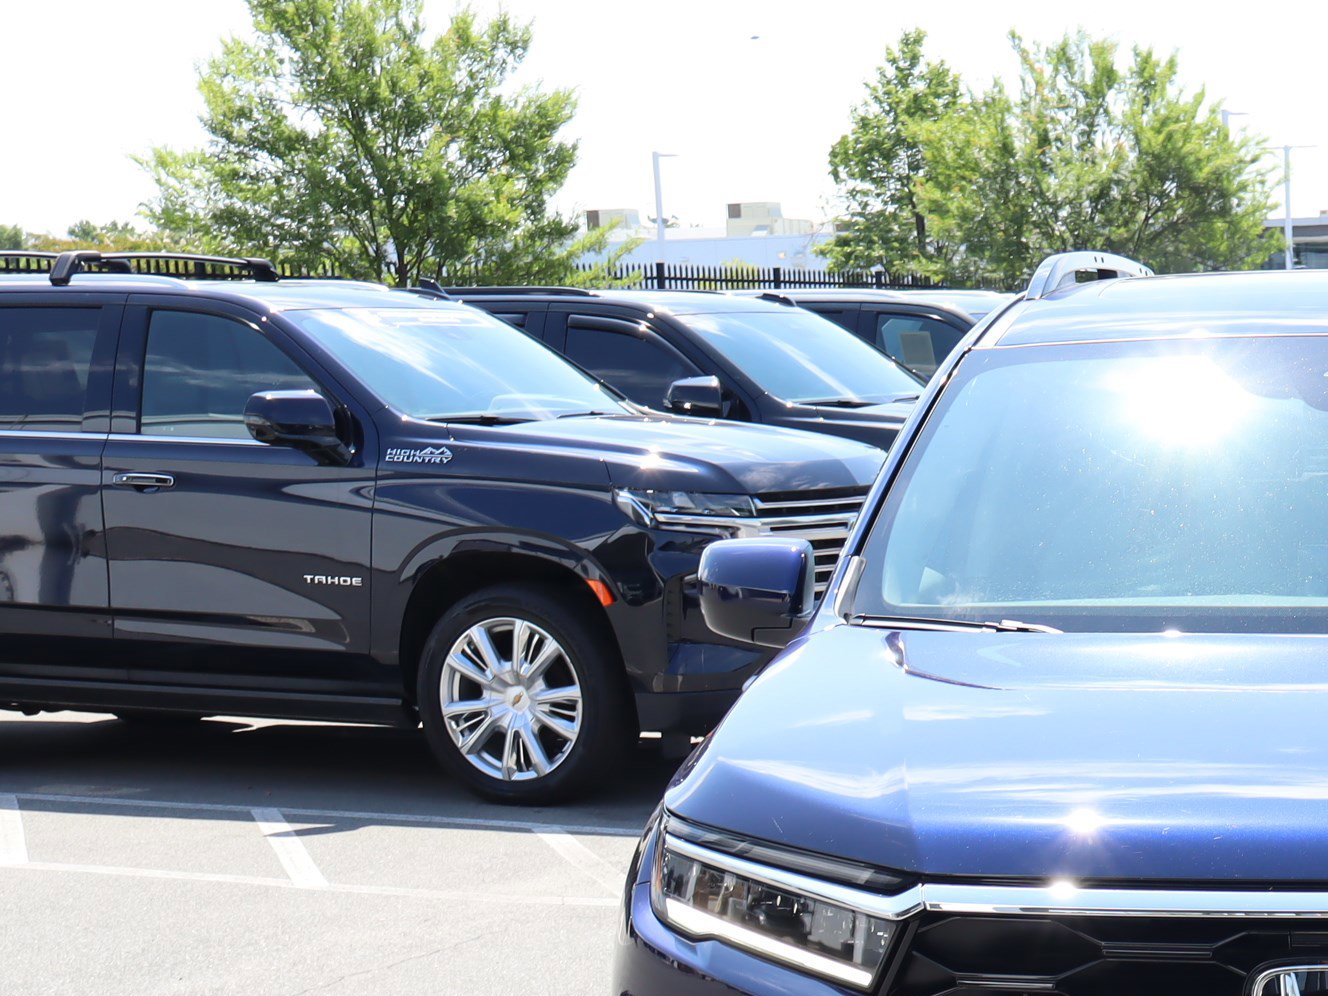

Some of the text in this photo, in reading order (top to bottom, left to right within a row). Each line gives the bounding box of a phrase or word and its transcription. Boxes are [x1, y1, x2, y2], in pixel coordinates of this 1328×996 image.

[386, 447, 421, 456] HIGH
[385, 455, 453, 464] COUNTRY
[303, 574, 363, 587] TAHOE
